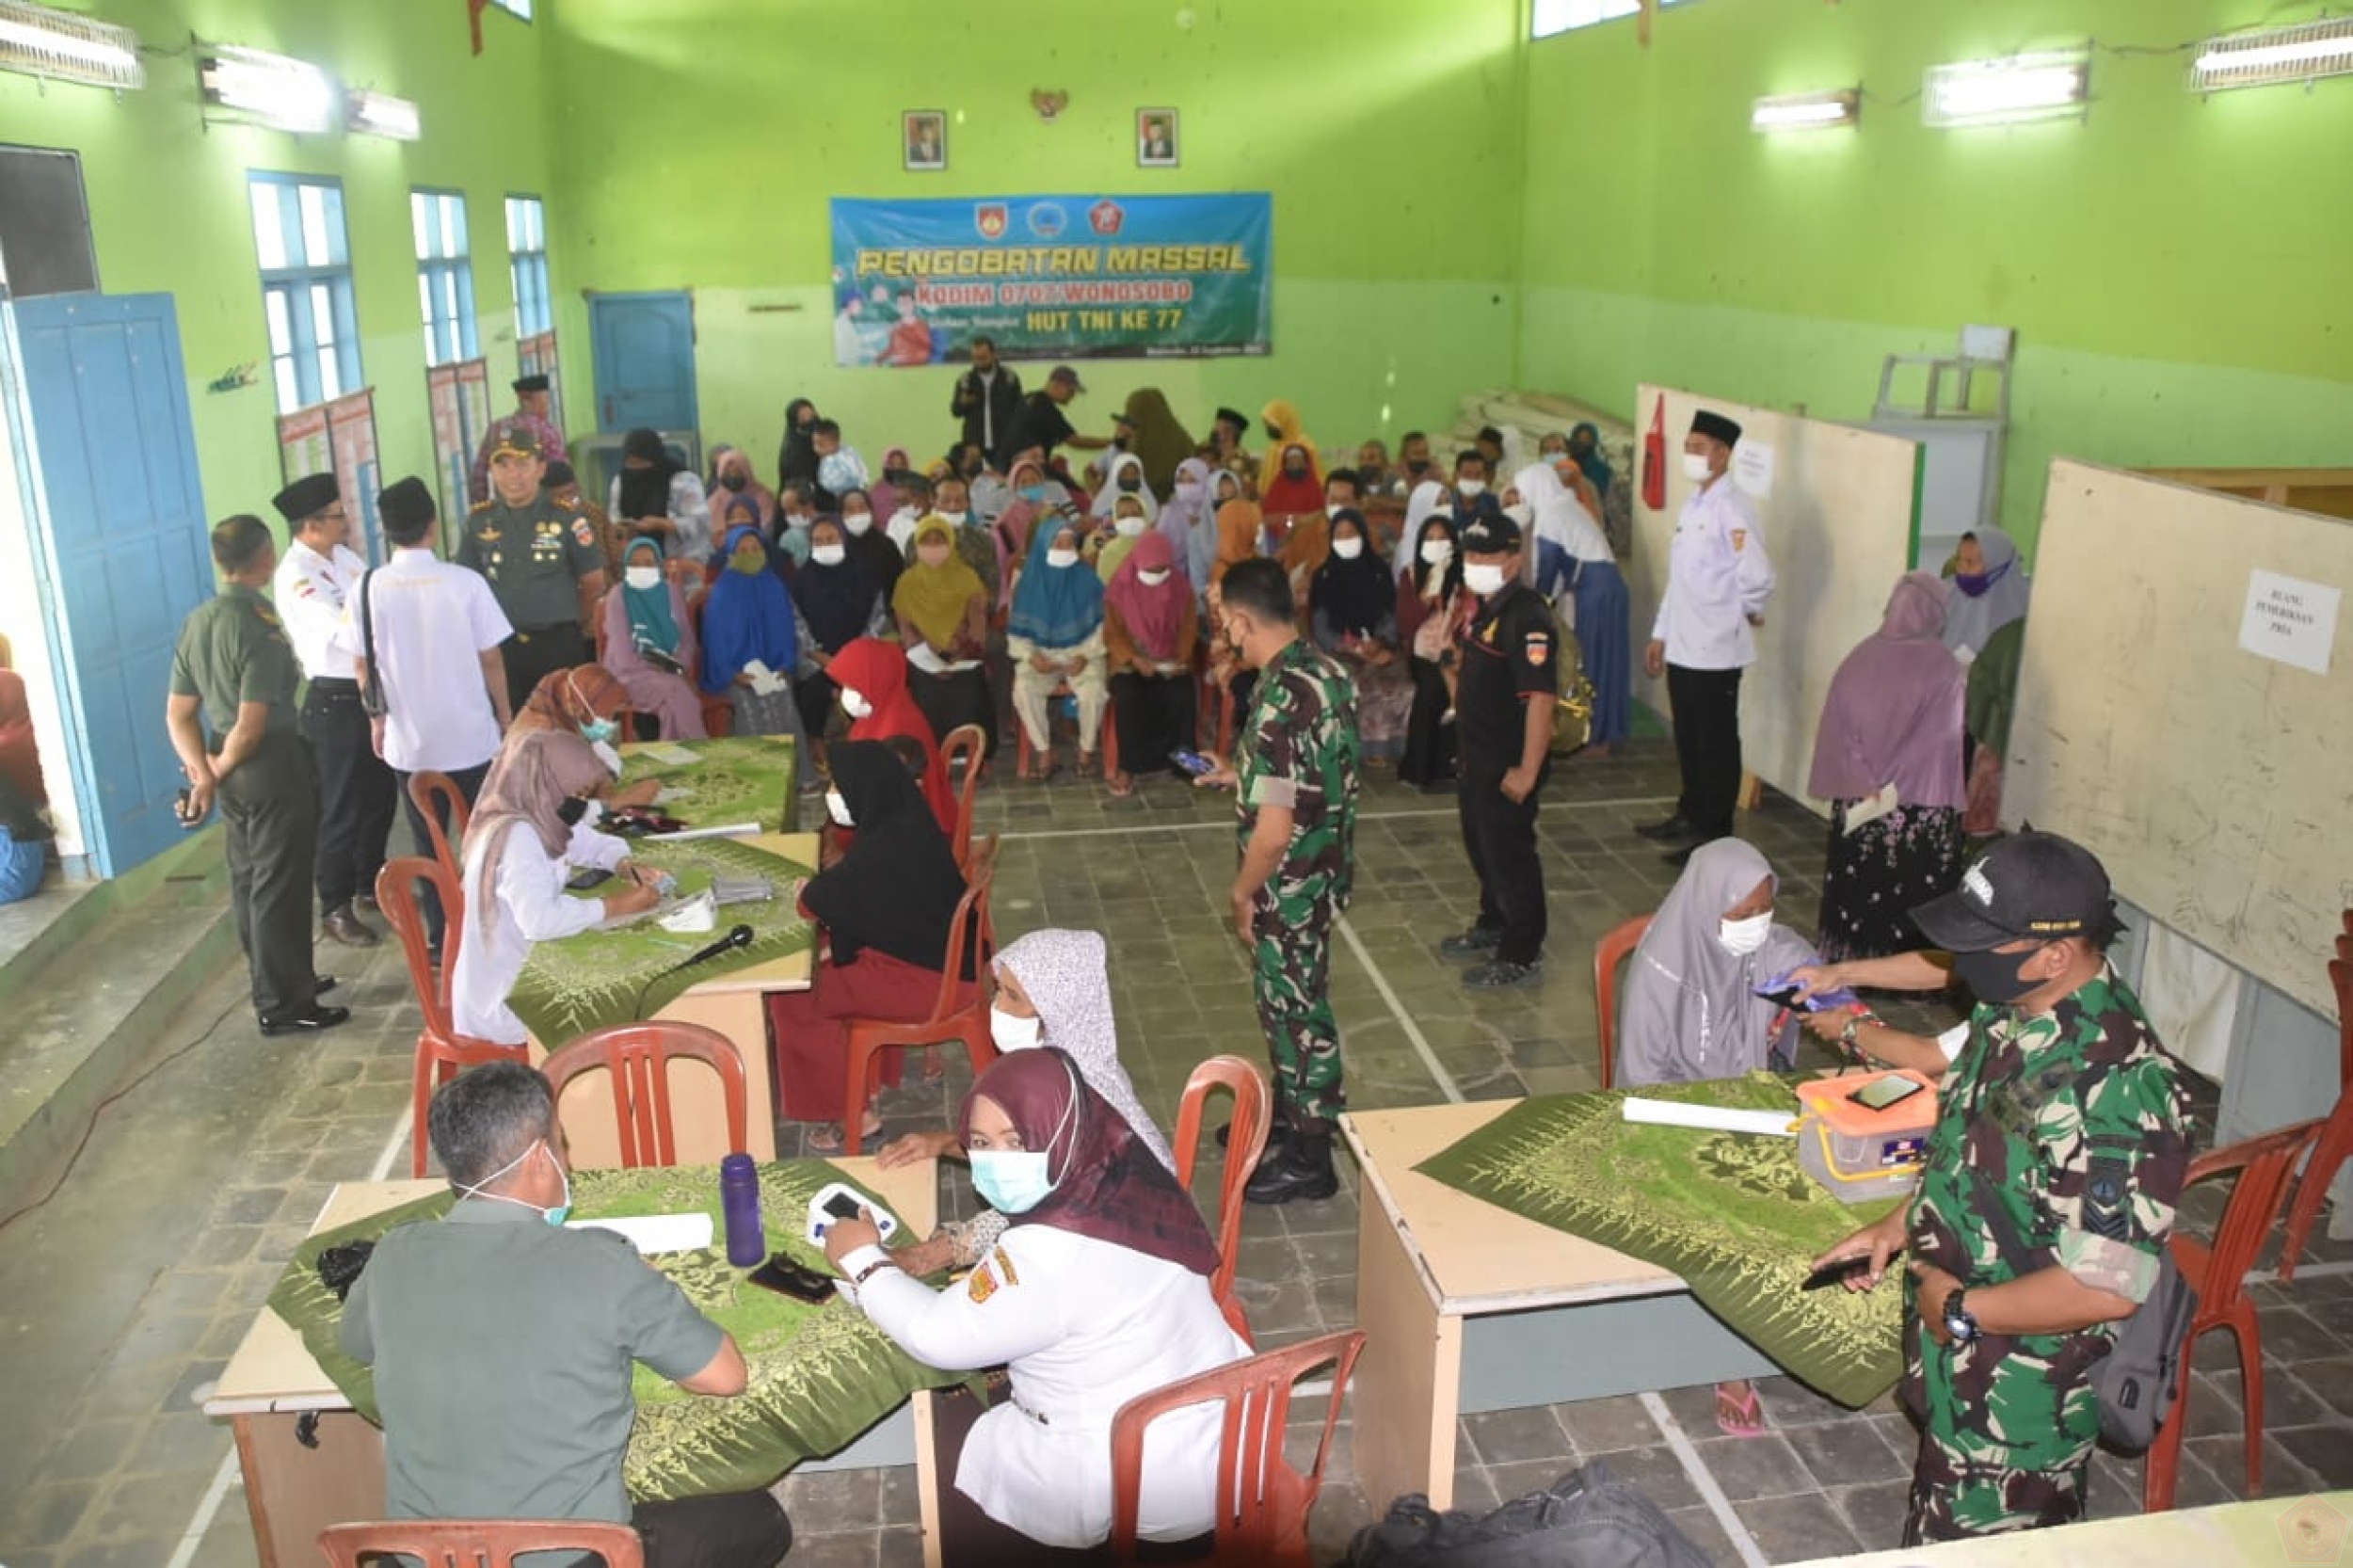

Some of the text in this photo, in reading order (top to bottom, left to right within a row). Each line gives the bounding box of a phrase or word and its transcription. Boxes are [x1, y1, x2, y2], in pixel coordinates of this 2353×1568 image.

[856, 245, 1251, 277] PENGOBATAN MASSAL
[916, 283, 994, 305] KODIM
[1028, 310, 1069, 330] HUT
[1078, 310, 1112, 330] TNI
[1121, 309, 1148, 329] KE
[1156, 309, 1182, 329] 77
